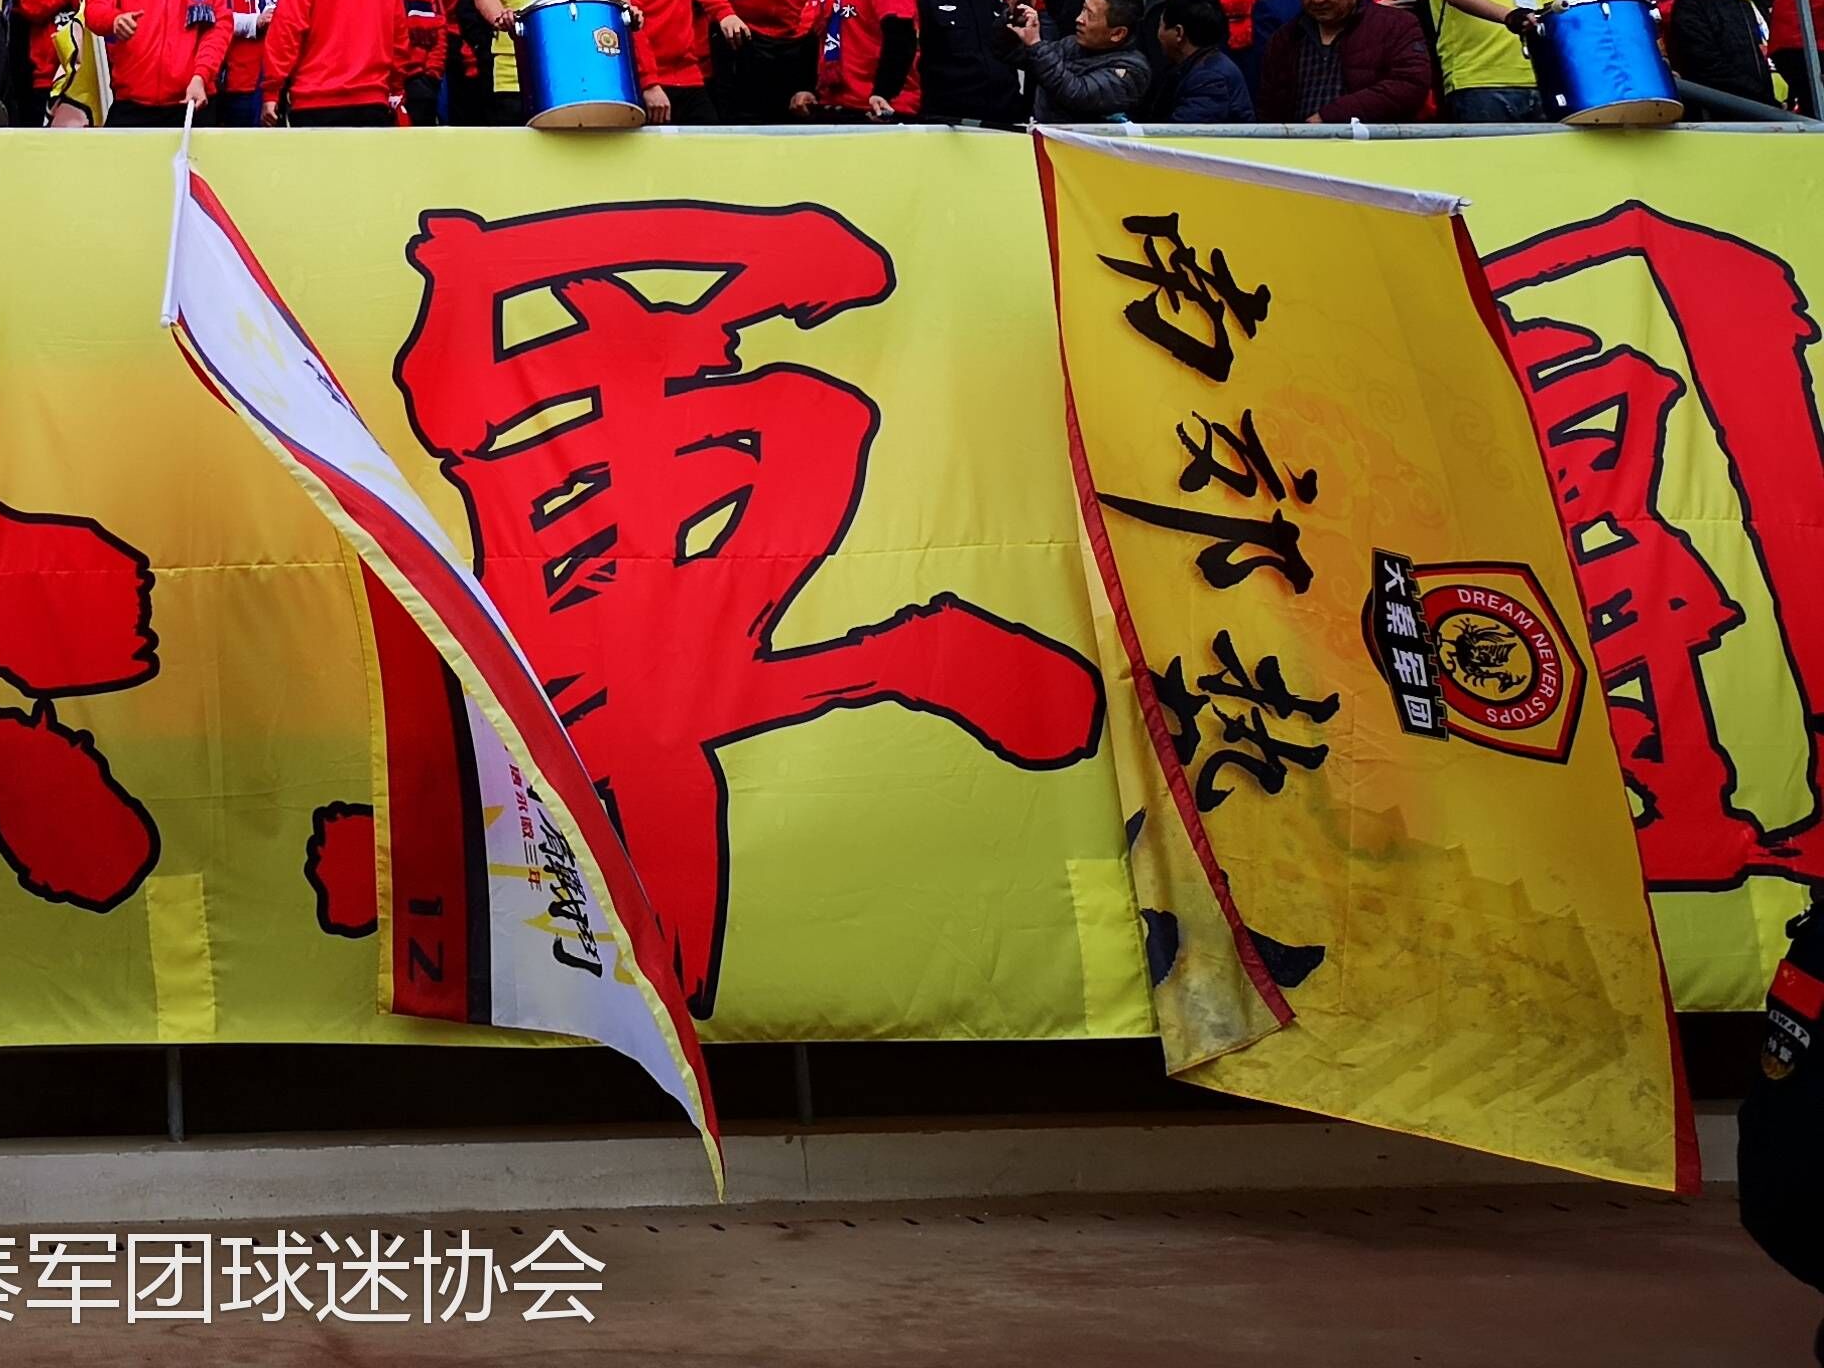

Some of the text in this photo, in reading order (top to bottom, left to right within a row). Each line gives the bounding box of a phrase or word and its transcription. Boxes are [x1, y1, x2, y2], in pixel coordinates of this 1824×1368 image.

[1383, 559, 1433, 729] 大秦军团
[1457, 589, 1558, 723] DREAM NEVER STOPS
